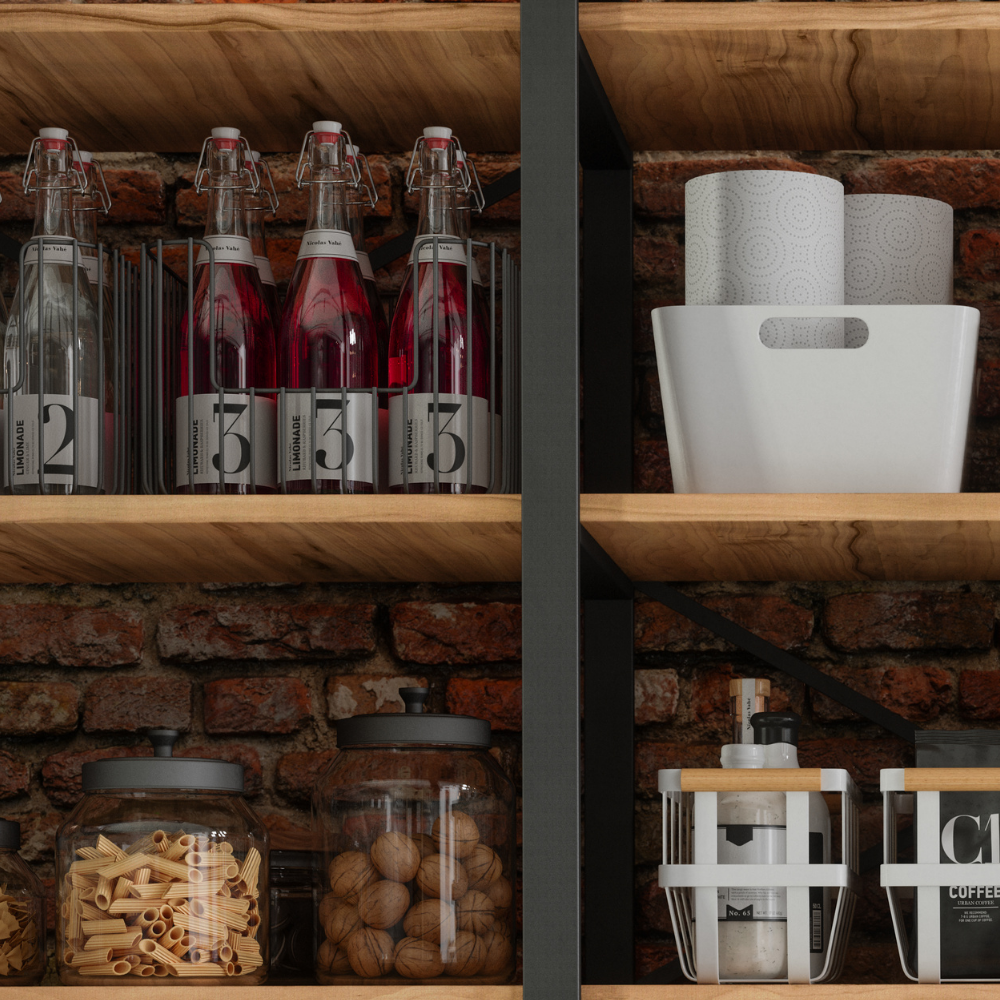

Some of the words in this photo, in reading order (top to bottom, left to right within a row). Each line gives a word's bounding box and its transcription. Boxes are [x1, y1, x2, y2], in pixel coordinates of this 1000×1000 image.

[37, 403, 74, 474] 2
[212, 402, 250, 474] 3
[314, 399, 354, 470] 3
[427, 402, 465, 473] 3
